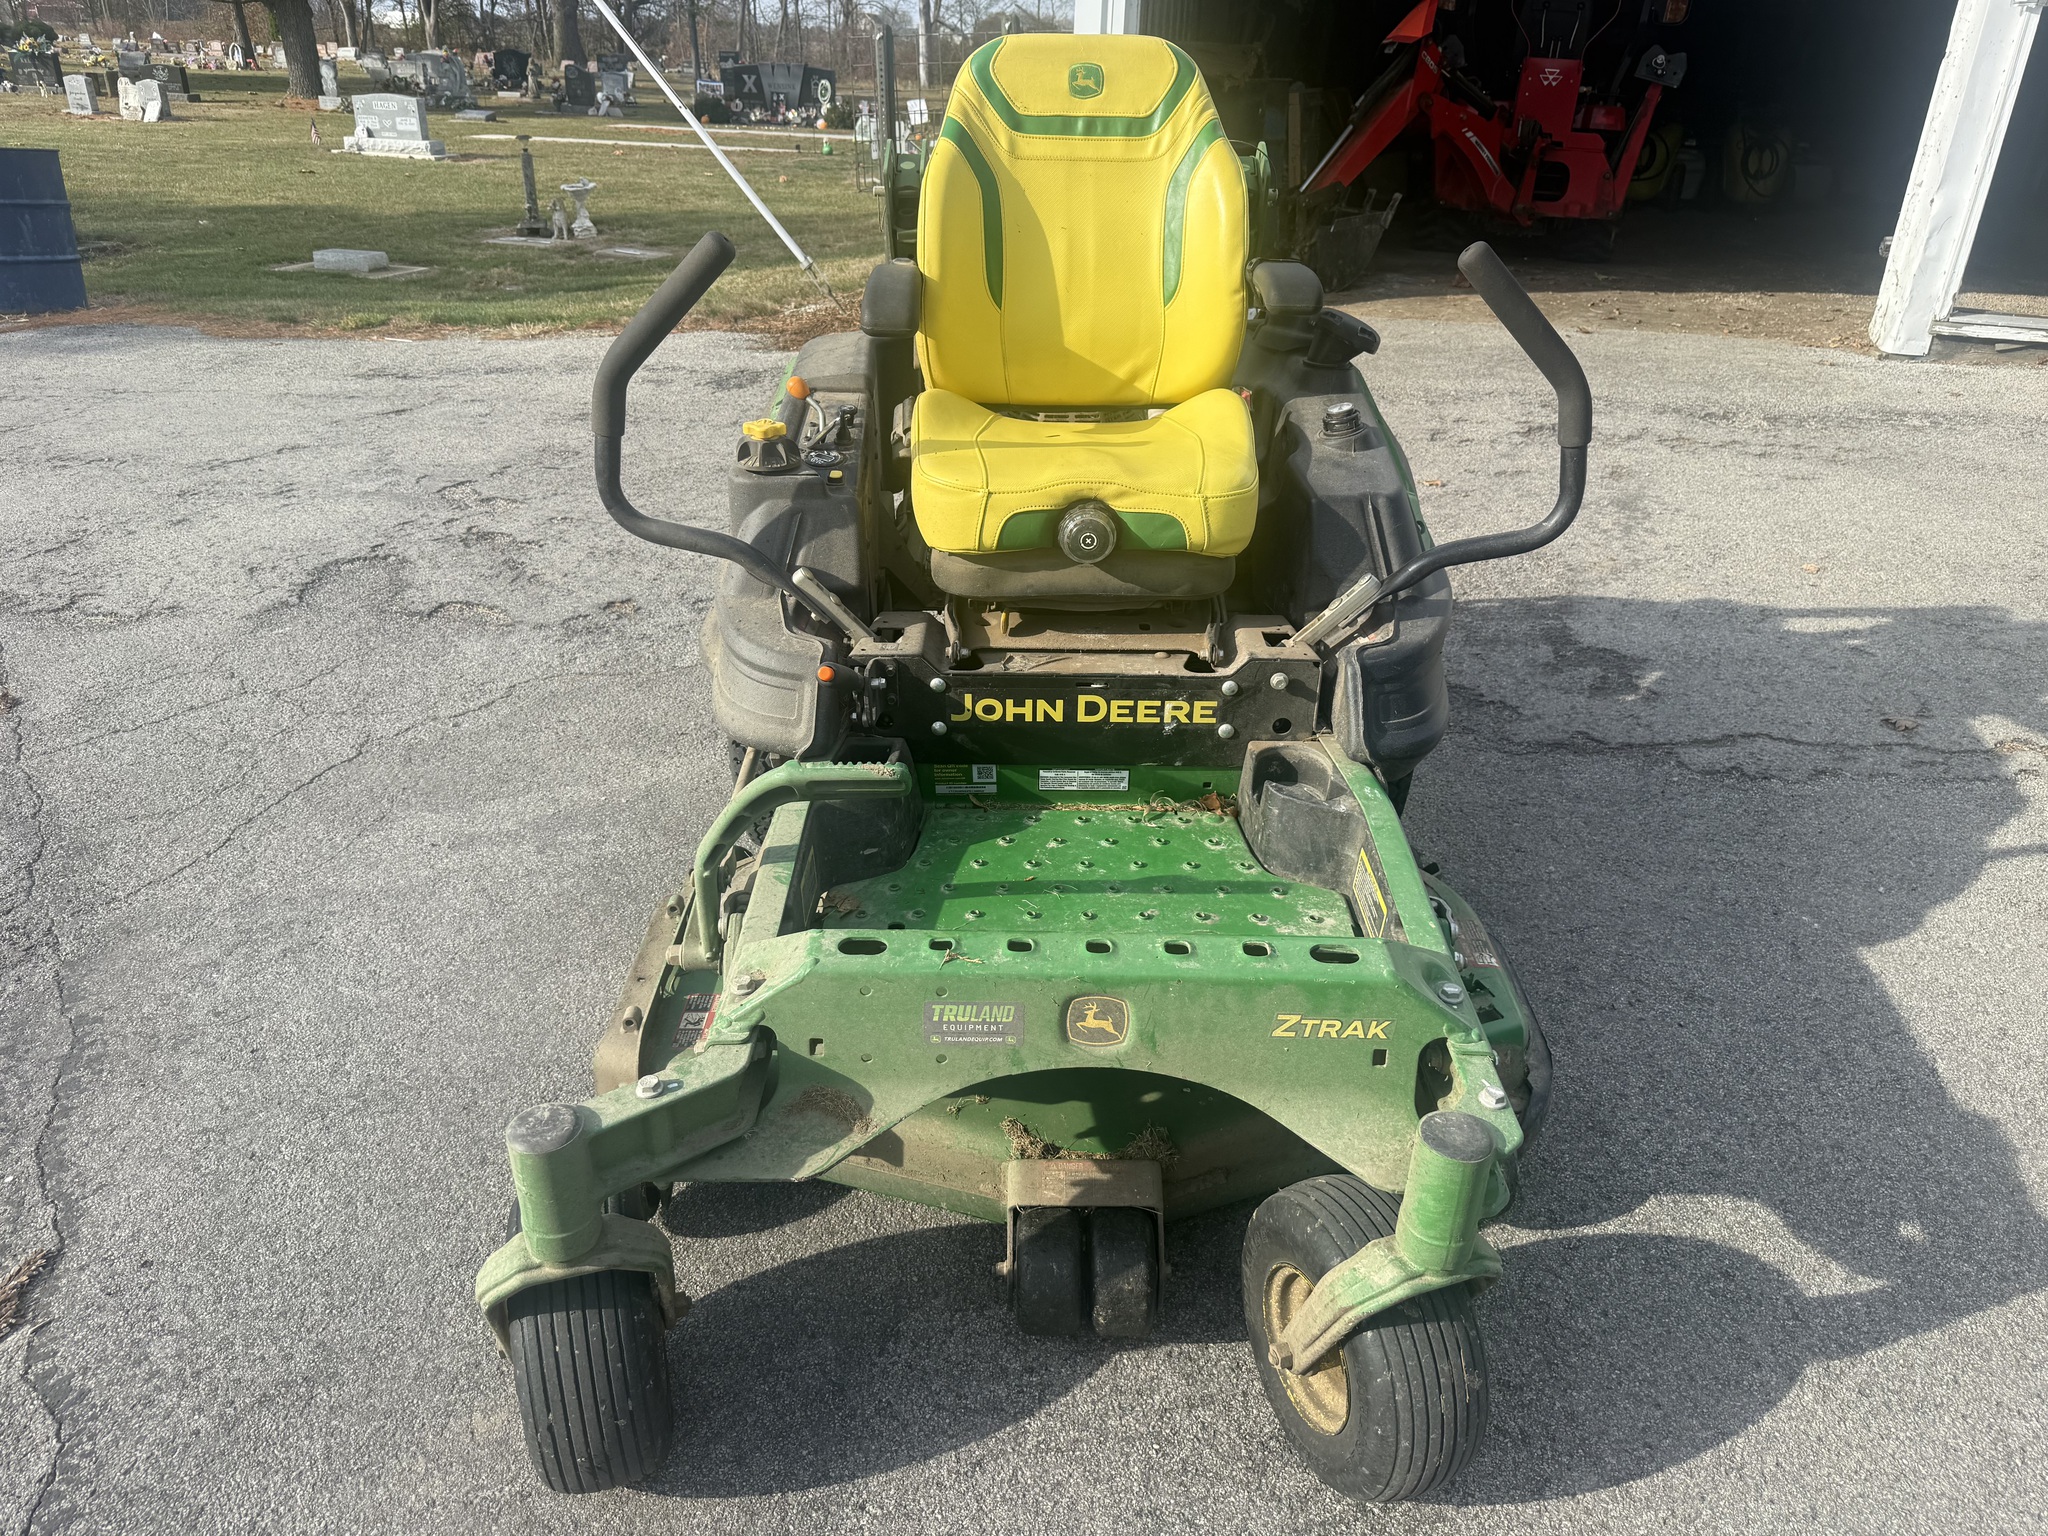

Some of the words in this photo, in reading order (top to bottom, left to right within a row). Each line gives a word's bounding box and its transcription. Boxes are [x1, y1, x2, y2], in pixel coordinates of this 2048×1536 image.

[742, 74, 758, 94] X
[951, 693, 1064, 723] JOHN
[1077, 694, 1218, 724] DEERE
[932, 1004, 1015, 1022] TRULAND
[942, 1024, 1004, 1032] EQUIPMENT
[1271, 1014, 1393, 1040] ZTRAK
